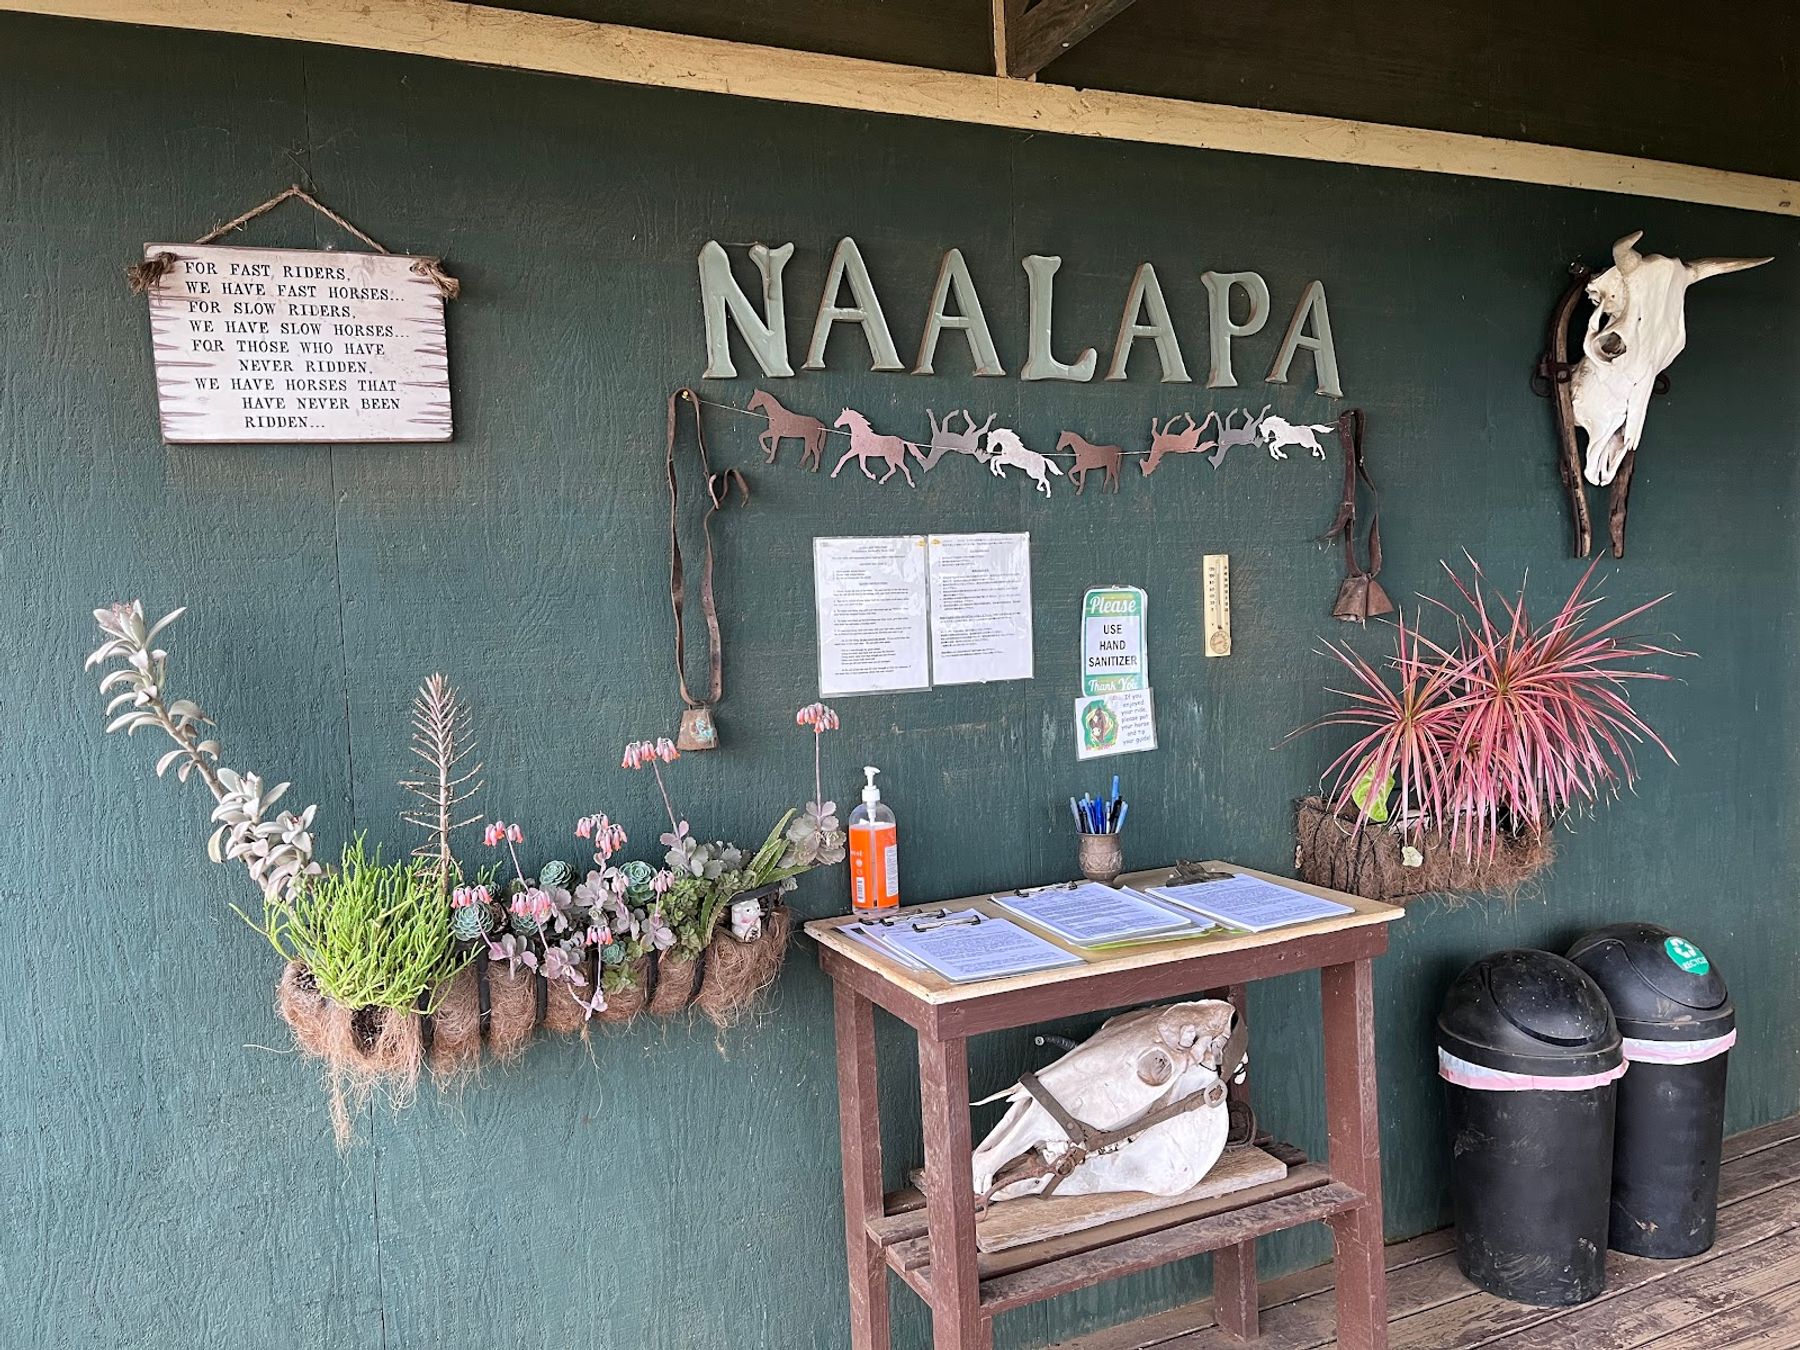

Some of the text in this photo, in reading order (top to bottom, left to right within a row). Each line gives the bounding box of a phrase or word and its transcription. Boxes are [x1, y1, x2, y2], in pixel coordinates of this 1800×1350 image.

[184, 261, 218, 275] FOR
[230, 263, 270, 277] FAST
[185, 281, 404, 302] WE HAVE FAST HORSES...
[189, 300, 221, 313] FOR
[233, 302, 276, 315] SLOW
[698, 236, 1344, 397] NAALAPA
[189, 320, 409, 338] WE HAVE SLOW HORSES...
[193, 339, 385, 355] FOR THOSE WHO HAVE
[239, 359, 293, 372] NEVER
[195, 377, 397, 392] WE HAVE HORSES THAT
[242, 397, 400, 410] HAVE NEVER BEEN
[245, 416, 325, 428] RIDDEN...
[1089, 595, 1137, 615] Please
[1103, 624, 1123, 635] USE
[1100, 640, 1126, 651] HAND
[1088, 655, 1138, 667] SANITIZER
[1088, 679, 1116, 692] Thank
